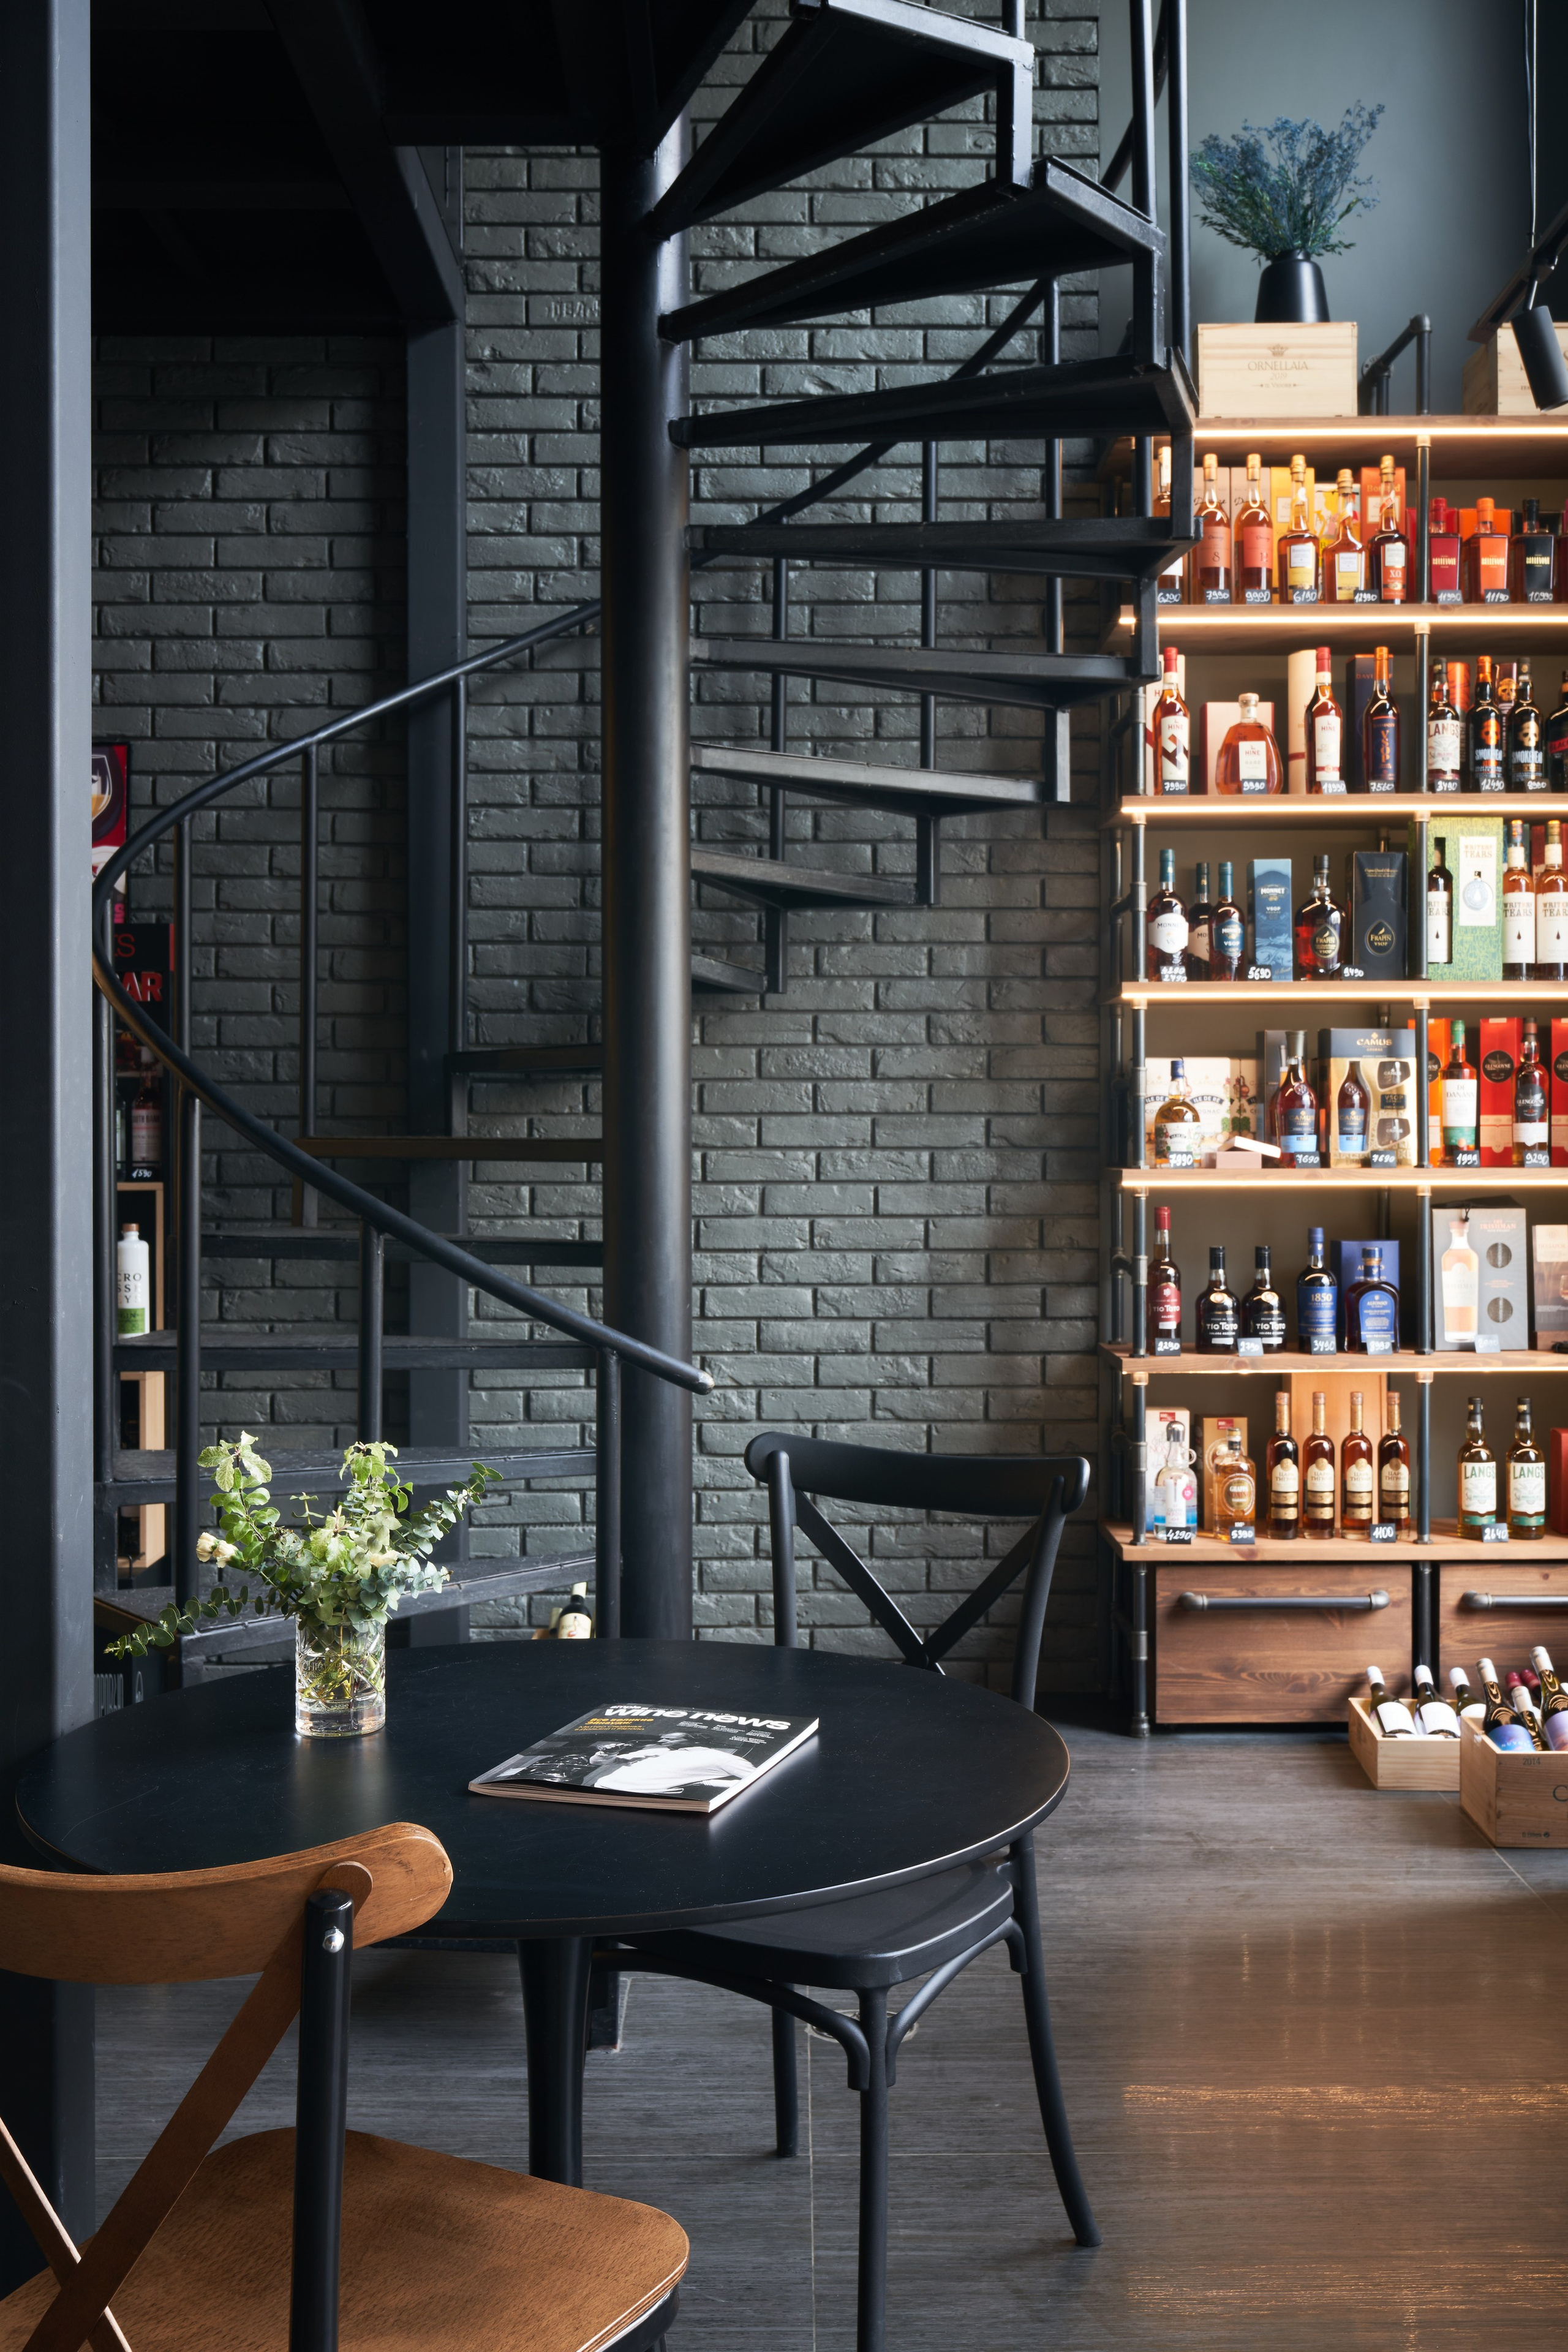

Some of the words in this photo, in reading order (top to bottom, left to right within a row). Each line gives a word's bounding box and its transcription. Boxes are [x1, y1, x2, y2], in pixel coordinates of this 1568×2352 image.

[1248, 361, 1308, 371] ORNELLAIA
[1212, 552, 1221, 562] 8
[1260, 552, 1268, 562] 12
[1157, 593, 1181, 603] 6290
[1205, 590, 1230, 600] 7990
[1245, 591, 1271, 602] 9990
[1428, 722, 1459, 739] LANGS
[1164, 782, 1186, 791] 7990
[1243, 781, 1265, 791] 9990
[1504, 909, 1532, 918] TEARS
[1247, 967, 1272, 981] 5690
[1169, 1154, 1193, 1168] 7990
[1456, 1153, 1478, 1166] 1999
[1526, 1153, 1549, 1166] 9290
[1311, 1293, 1333, 1302] 1850
[1464, 1465, 1495, 1480] LANGS
[1513, 1465, 1544, 1480] LANGS
[1166, 1529, 1193, 1540] 4290
[1373, 1526, 1393, 1539] 1100
[604, 1707, 688, 1718] wine
[688, 1713, 791, 1730] news
